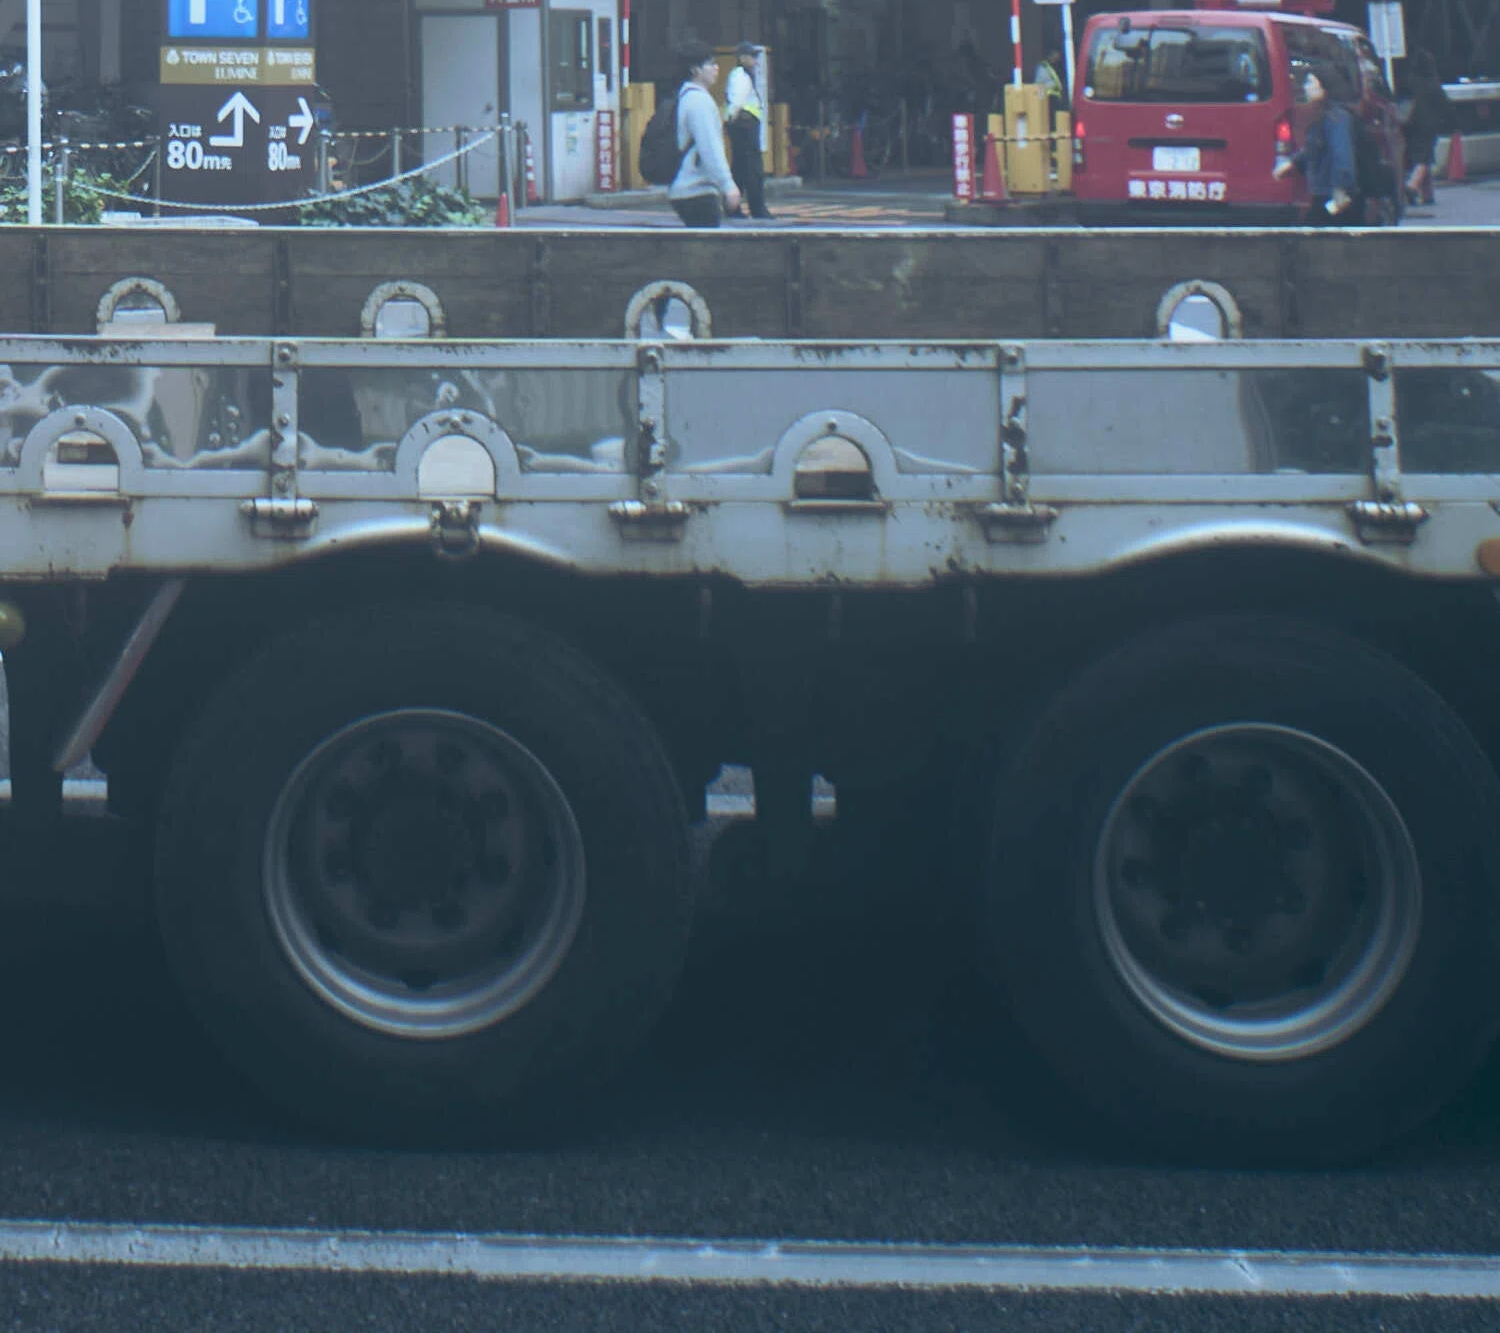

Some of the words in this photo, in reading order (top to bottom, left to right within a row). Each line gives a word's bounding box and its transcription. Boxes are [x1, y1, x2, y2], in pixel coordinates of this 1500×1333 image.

[181, 51, 216, 65] TOWN
[218, 51, 259, 65] SEVEN
[168, 124, 203, 138] 入口は
